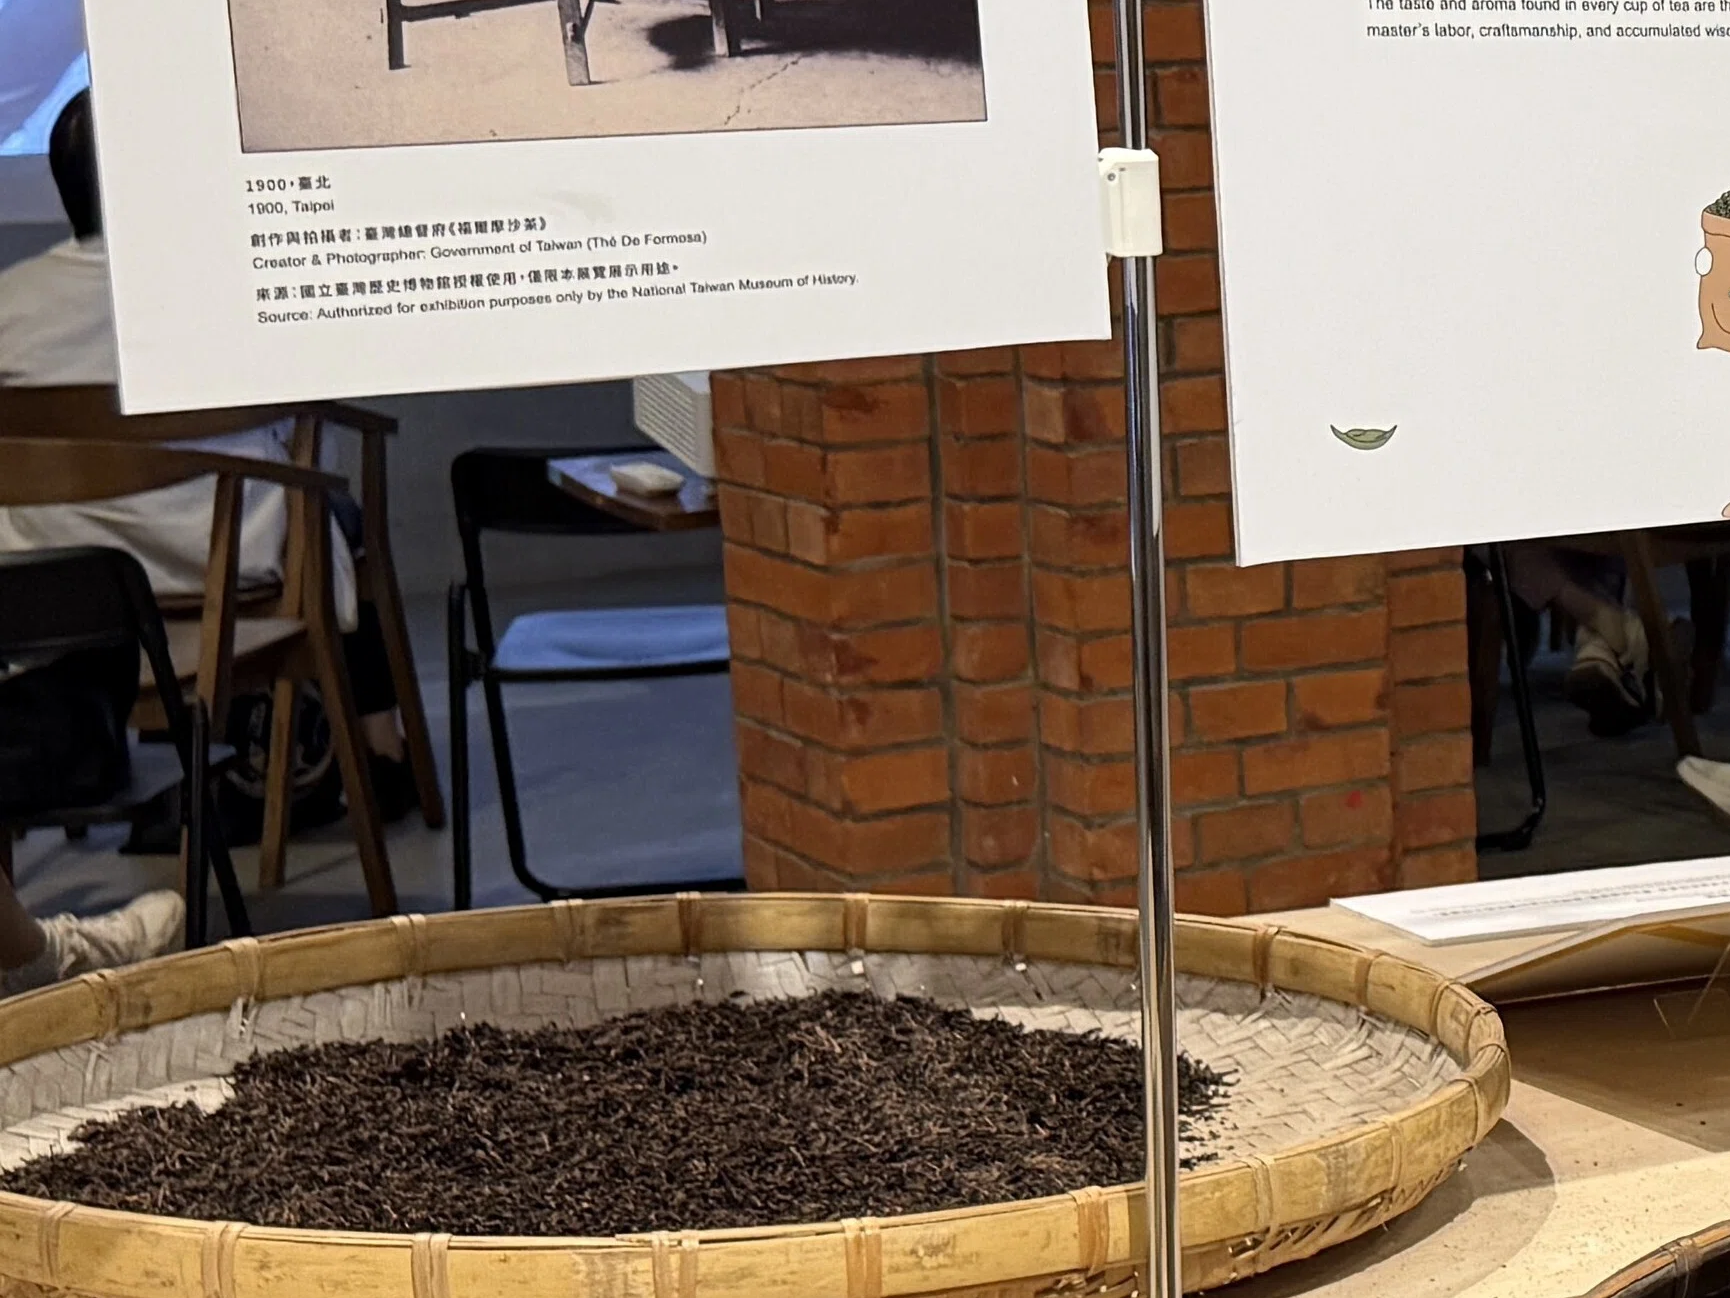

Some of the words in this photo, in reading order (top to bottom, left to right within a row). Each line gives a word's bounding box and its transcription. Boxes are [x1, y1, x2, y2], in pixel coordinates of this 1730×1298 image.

[1580, 0, 1620, 15] every
[1622, 0, 1648, 15] cup
[1692, 0, 1716, 12] are
[1433, 21, 1475, 40] labor,
[1477, 22, 1582, 41] craftsmanship,
[1585, 23, 1612, 38] and
[1614, 22, 1701, 38] accumulated
[246, 200, 288, 215] 1900,
[290, 198, 335, 215] Taipei
[251, 255, 307, 270] Creator
[310, 252, 322, 266] &
[325, 248, 426, 265] Photographer:
[429, 241, 516, 259] Government
[518, 239, 532, 254] of
[534, 238, 583, 252] Taiwan
[643, 229, 707, 246] Formosa)
[256, 309, 313, 324] Source:
[315, 302, 393, 320] Authorized
[395, 300, 416, 314] for
[418, 297, 486, 313] exhibition
[487, 293, 552, 310] purposes
[554, 289, 584, 305] only
[585, 288, 603, 303] by
[606, 287, 629, 300] the
[630, 281, 686, 298] National
[688, 280, 735, 294] Taiwan
[737, 277, 794, 291] Museum
[795, 273, 809, 287] of
[811, 273, 859, 286] History.
